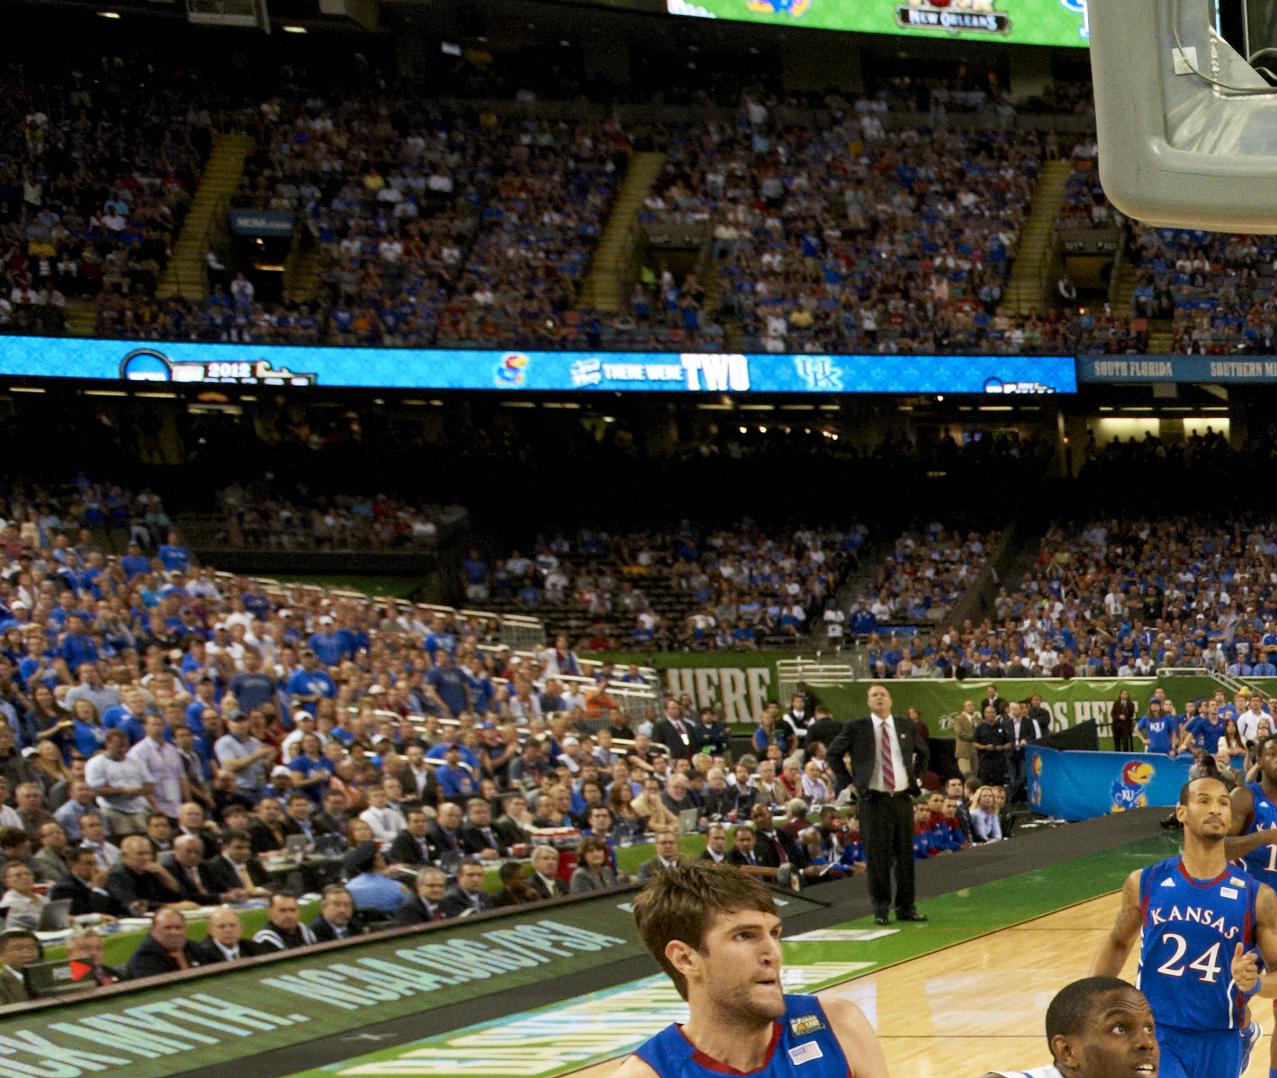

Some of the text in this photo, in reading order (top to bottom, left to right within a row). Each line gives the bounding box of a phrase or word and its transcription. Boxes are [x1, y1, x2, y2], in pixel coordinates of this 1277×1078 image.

[207, 361, 251, 379] 2012
[680, 353, 750, 392] TWO
[1094, 360, 1173, 377] SOUTH FLORIDA
[1210, 361, 1262, 378] SOUTHERN
[1150, 721, 1165, 732] KU
[1150, 905, 1240, 941] KANSAS
[1157, 932, 1222, 984] 24
[49, 992, 310, 1066] MYTH.
[262, 919, 627, 1010] NCAA.ORG/PSA
